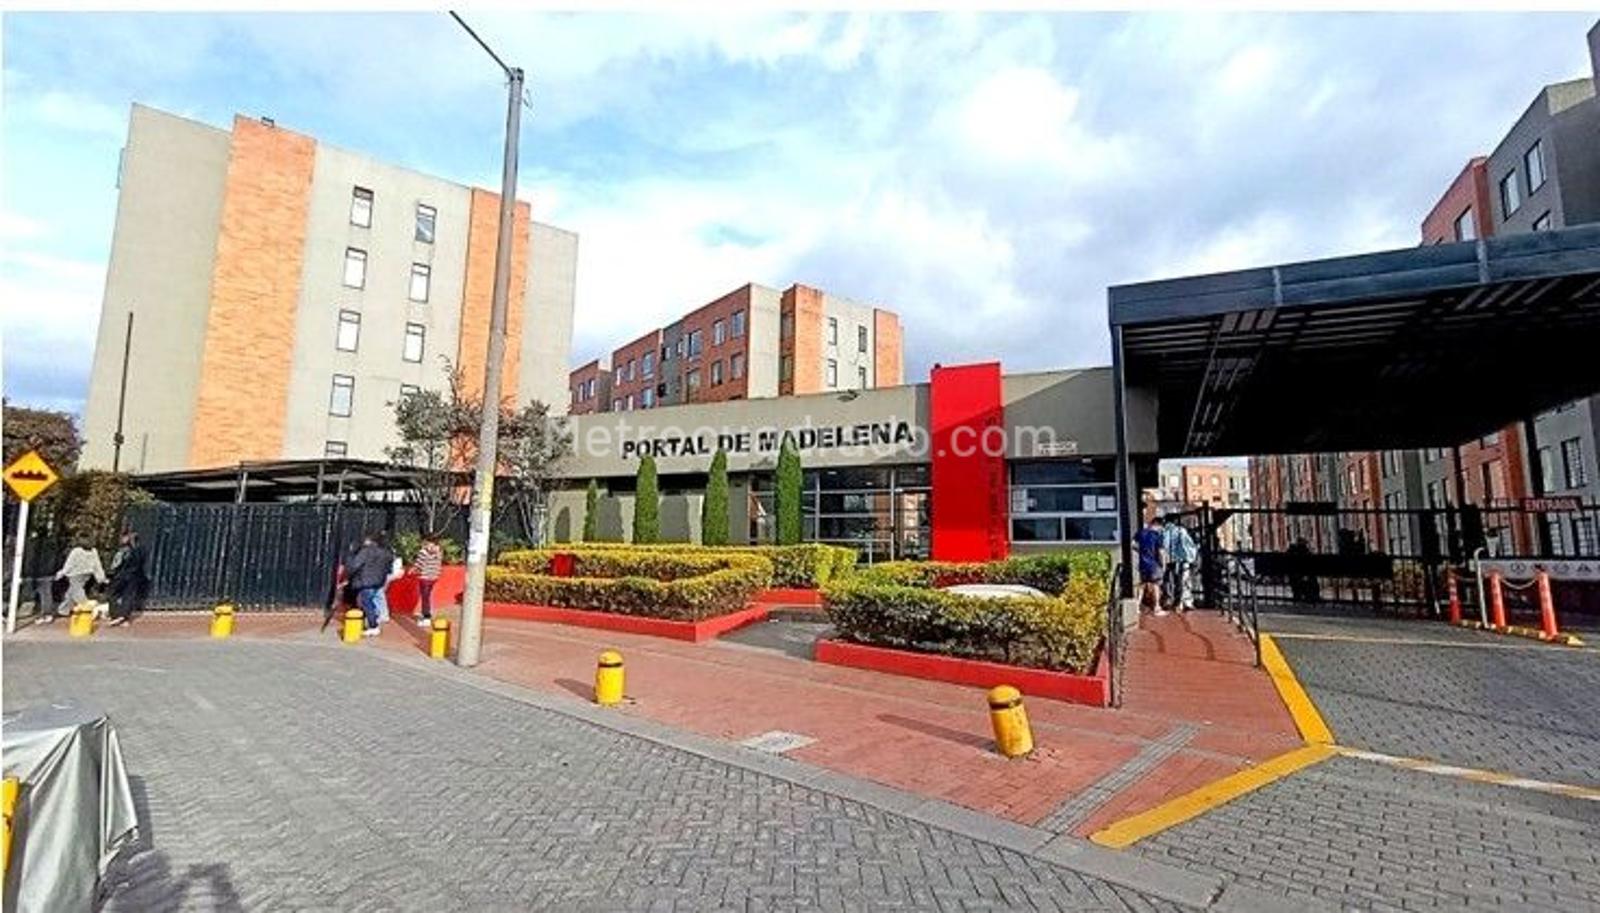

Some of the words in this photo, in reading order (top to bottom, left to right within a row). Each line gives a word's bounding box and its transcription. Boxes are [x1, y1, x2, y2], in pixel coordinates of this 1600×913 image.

[622, 435, 709, 459] PORTAL
[718, 432, 750, 453] DE
[759, 421, 914, 452] MADELENA
